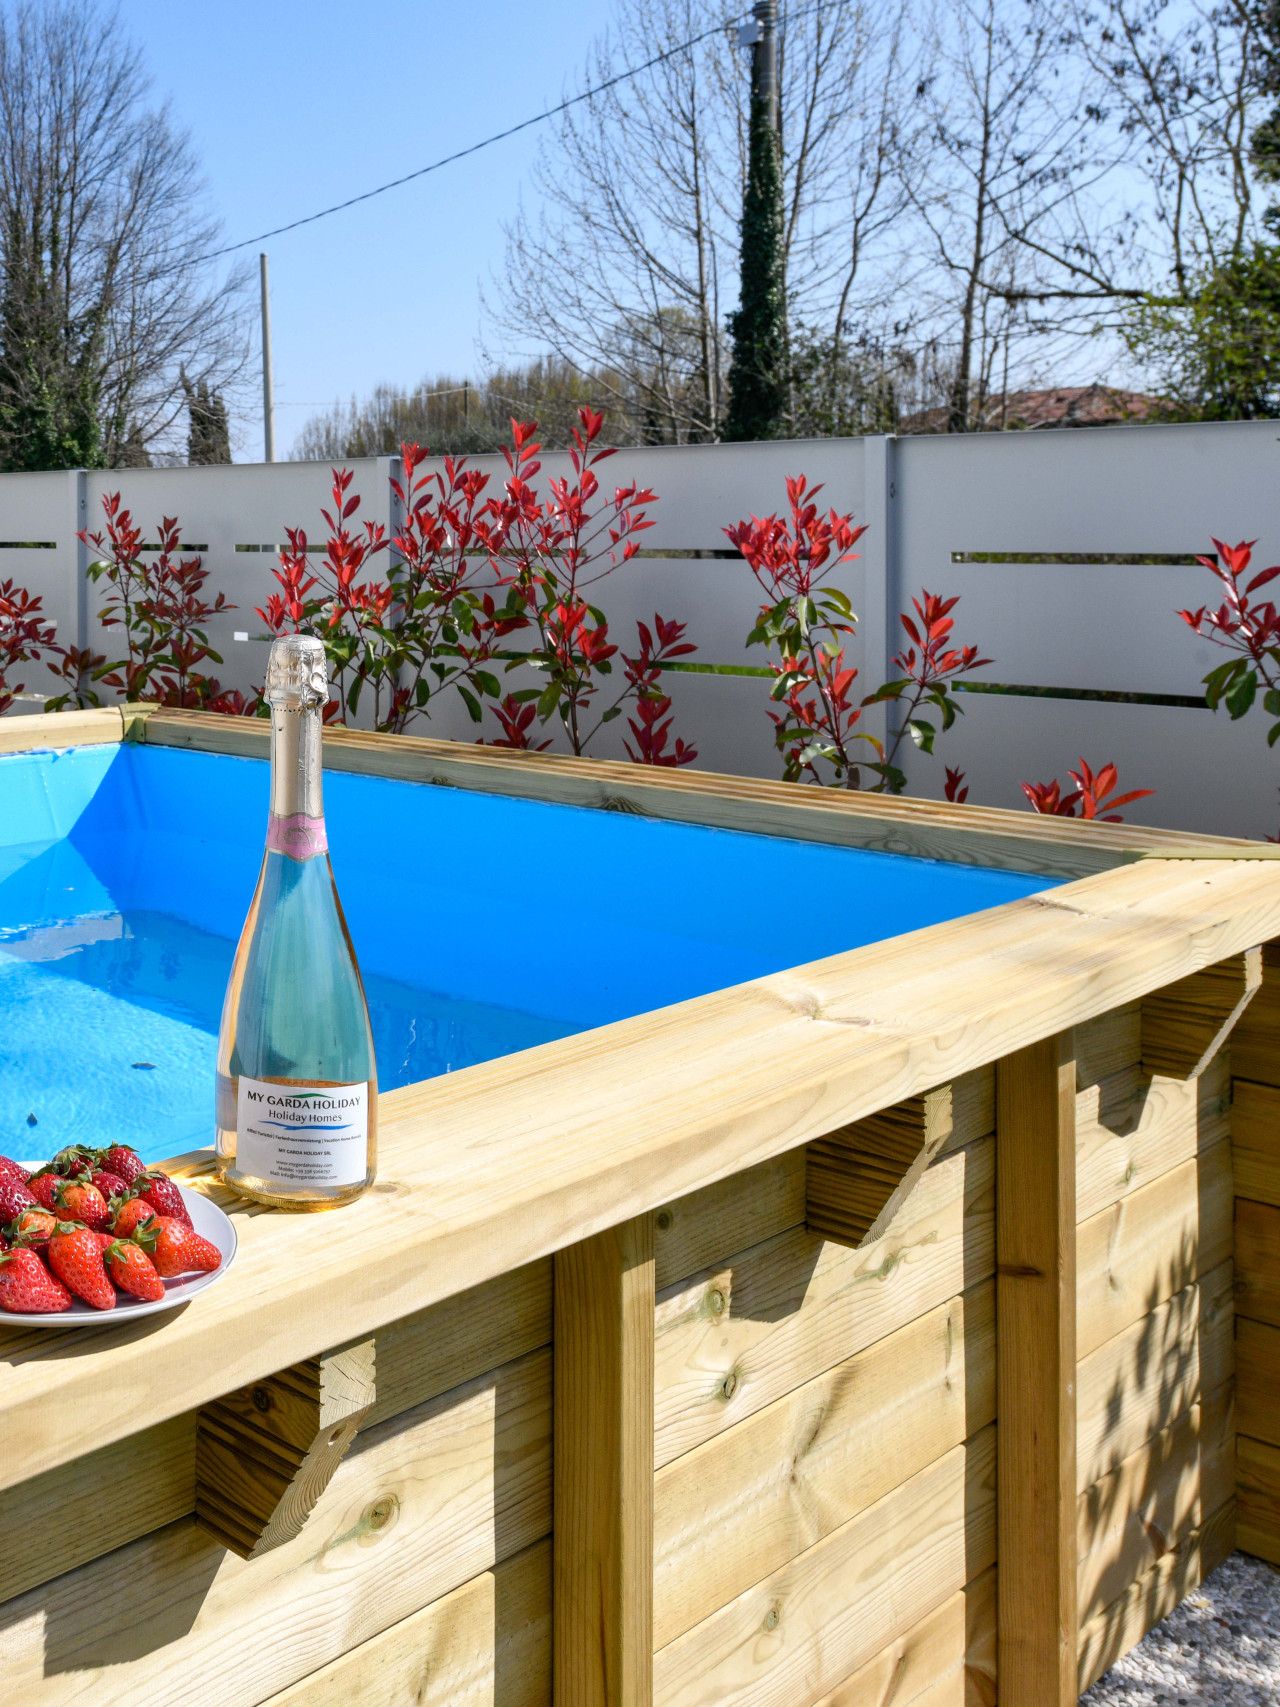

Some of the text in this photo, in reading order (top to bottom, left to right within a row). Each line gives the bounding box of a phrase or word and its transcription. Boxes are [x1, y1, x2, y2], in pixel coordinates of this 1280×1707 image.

[247, 1091, 361, 1110] MY GARDA HOLIDAY
[269, 1109, 342, 1124] Holiday Homes
